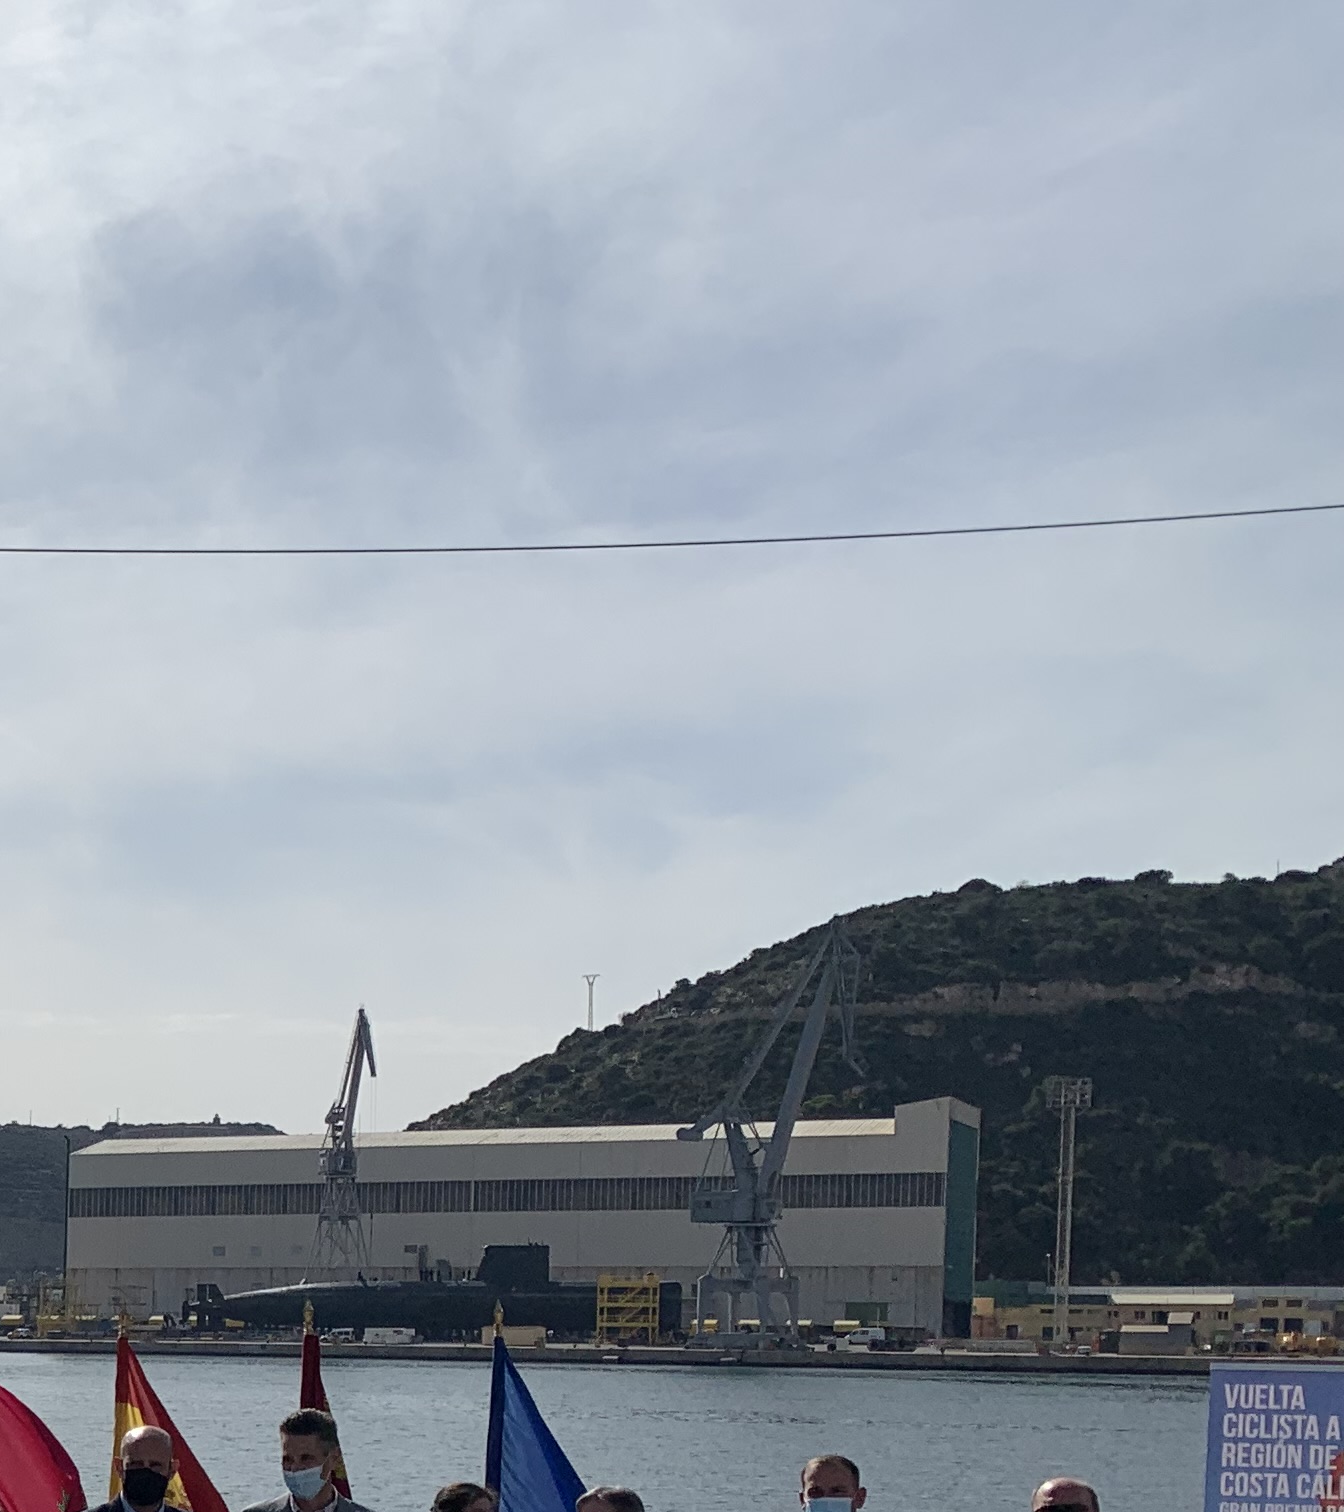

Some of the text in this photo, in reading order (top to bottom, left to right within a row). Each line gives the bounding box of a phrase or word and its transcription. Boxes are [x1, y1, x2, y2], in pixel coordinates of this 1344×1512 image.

[1224, 1383, 1306, 1410] VUELTA
[1223, 1413, 1342, 1440] CICLISTA A
[1221, 1439, 1339, 1470] REGIÓN DE
[1220, 1471, 1290, 1498] COSTA
